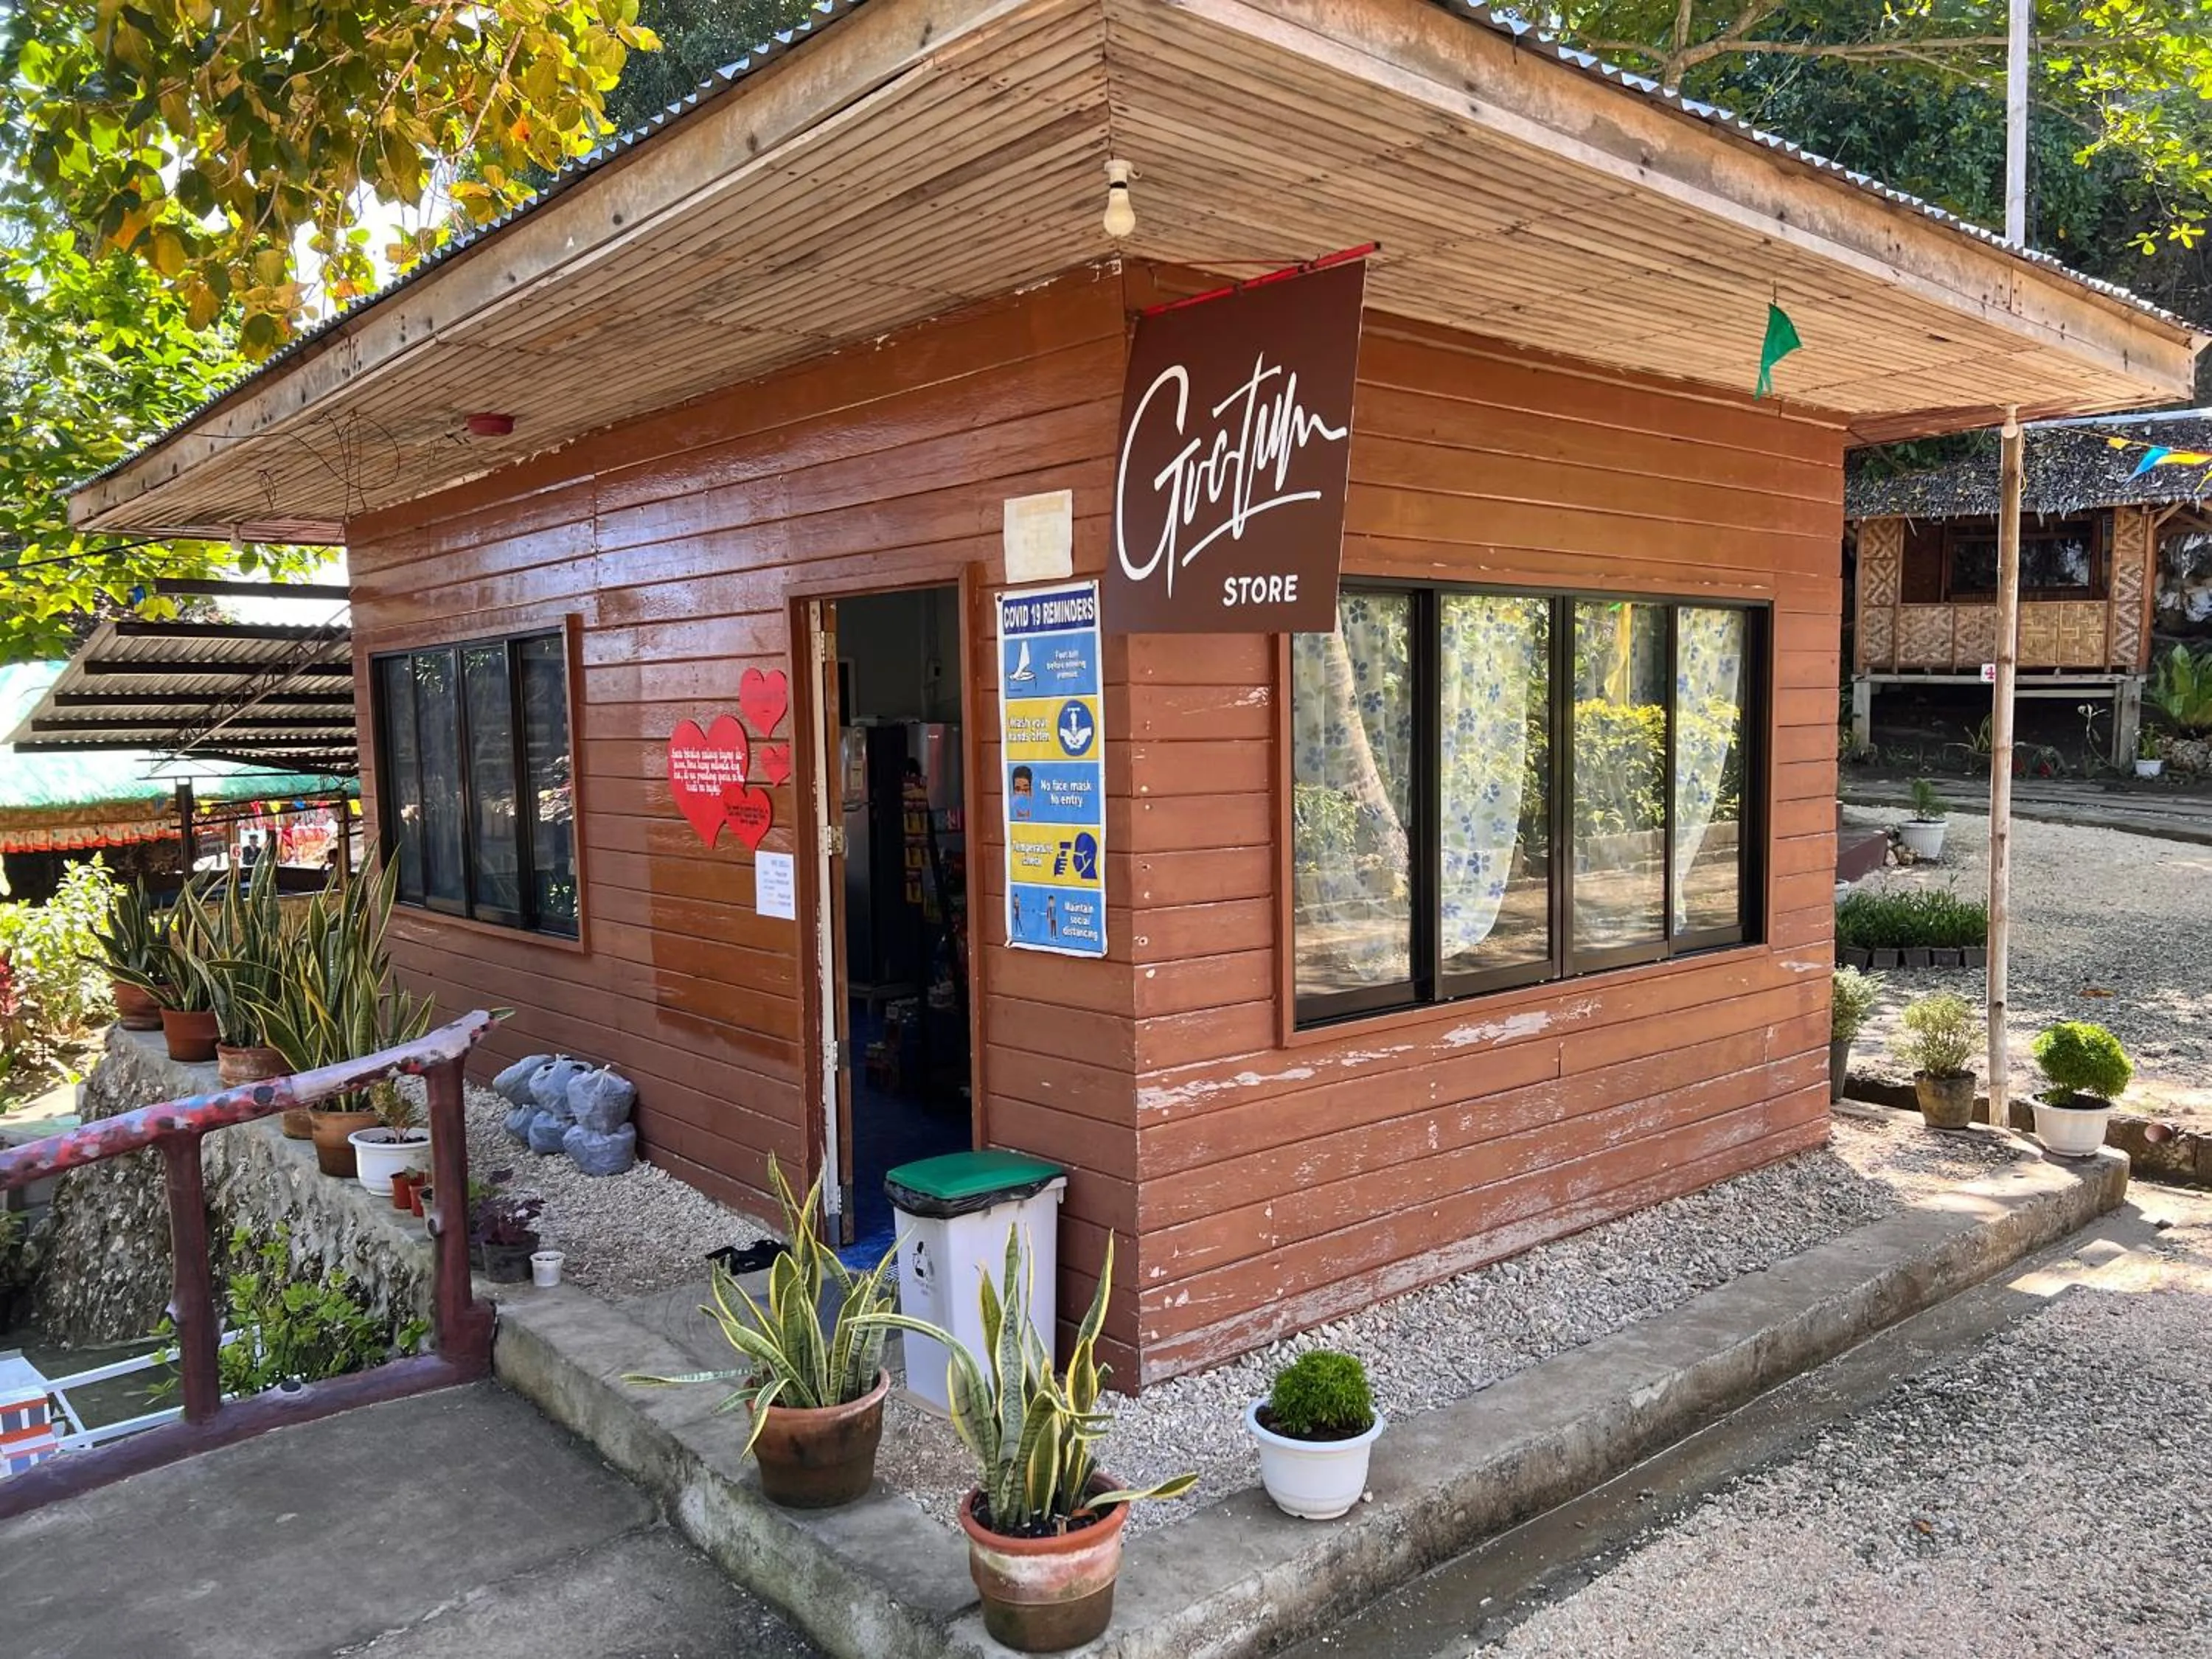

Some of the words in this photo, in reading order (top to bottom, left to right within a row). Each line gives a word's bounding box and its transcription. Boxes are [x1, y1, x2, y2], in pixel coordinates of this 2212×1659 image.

[1223, 574, 1299, 607] STORE
[1004, 605, 1029, 629] COVID
[1031, 602, 1042, 626] 19
[1043, 597, 1094, 625] REMINDERS
[1040, 779, 1051, 791] No
[1051, 779, 1068, 791] face
[1070, 779, 1092, 792] mask
[1060, 794, 1083, 808] entry
